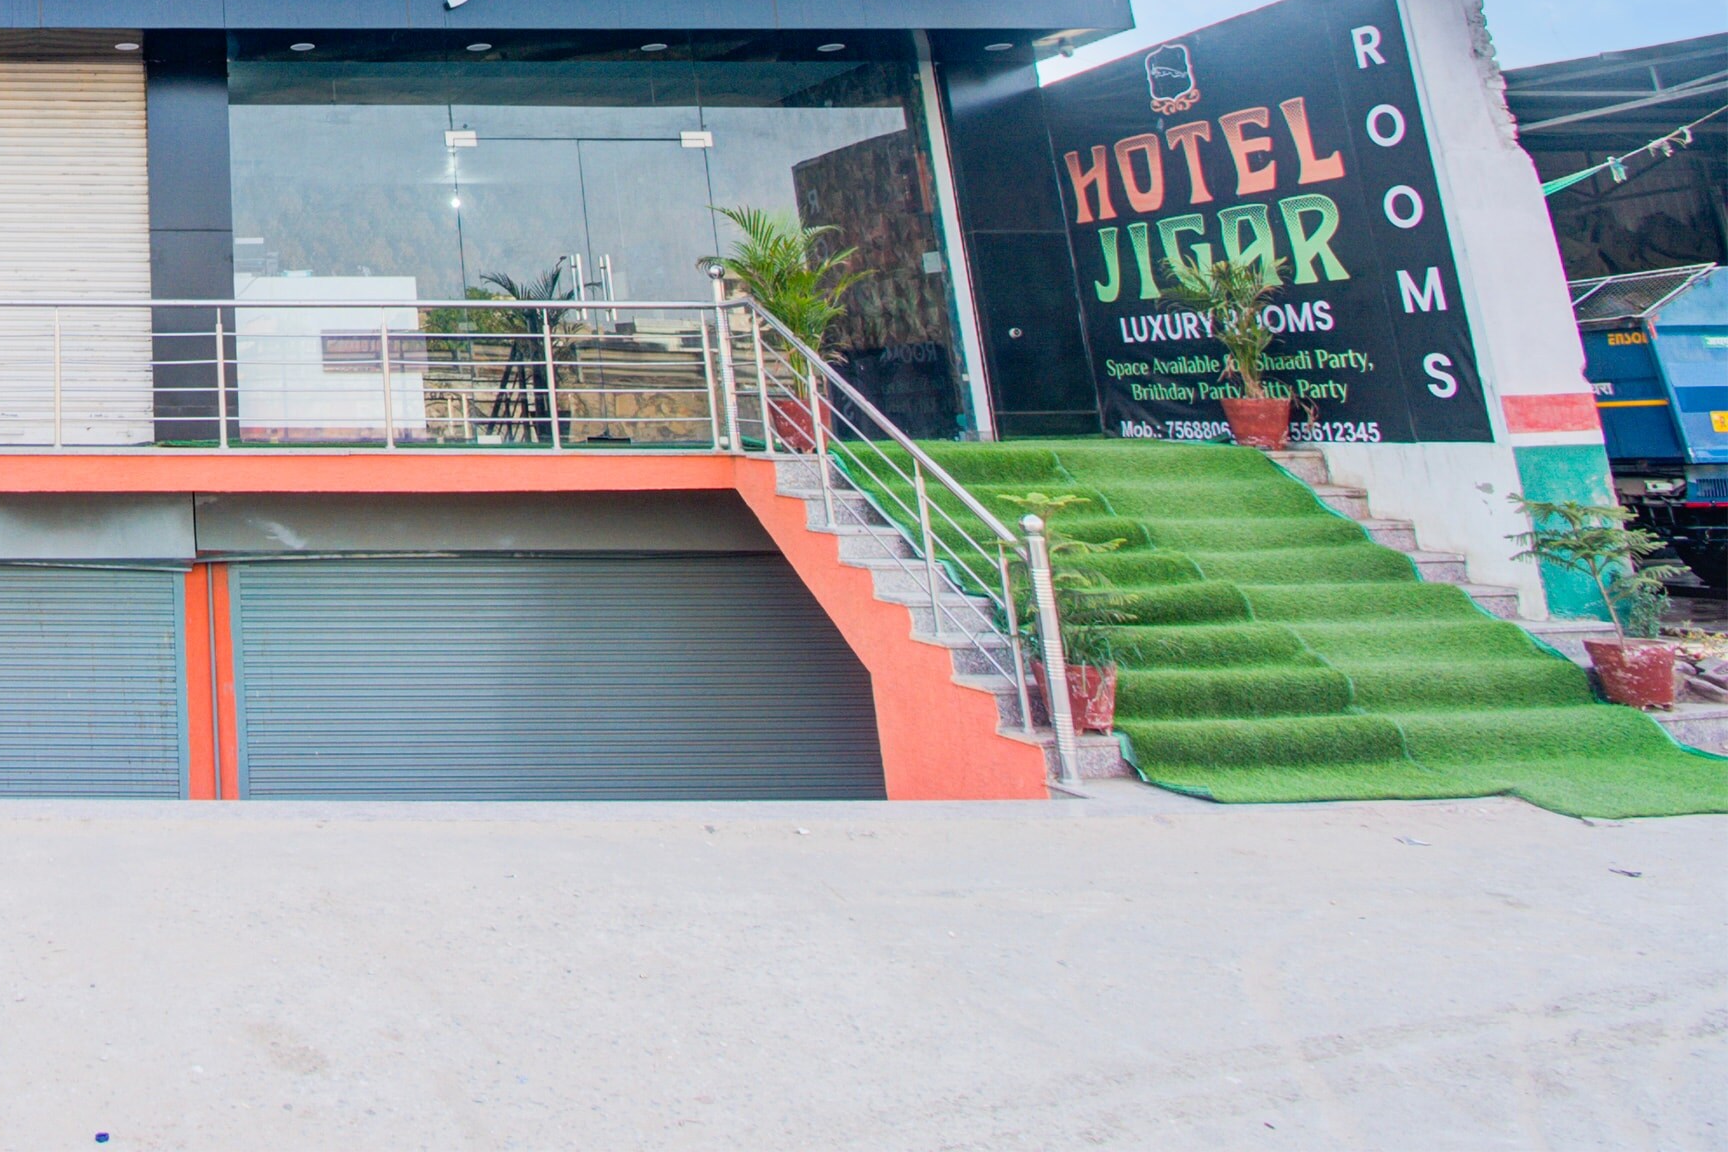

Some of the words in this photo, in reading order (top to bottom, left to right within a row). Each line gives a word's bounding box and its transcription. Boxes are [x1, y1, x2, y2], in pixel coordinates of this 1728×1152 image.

[1063, 96, 1346, 224] HOTEL
[1094, 193, 1351, 303] JIGAR
[1120, 309, 1214, 344] LUXURY
[1106, 358, 1148, 378] Space
[1153, 354, 1219, 375] Available
[1314, 349, 1374, 373] Party,
[1130, 382, 1195, 404] Brithday
[1297, 378, 1348, 404] Party
[1286, 421, 1381, 443] 55612345
